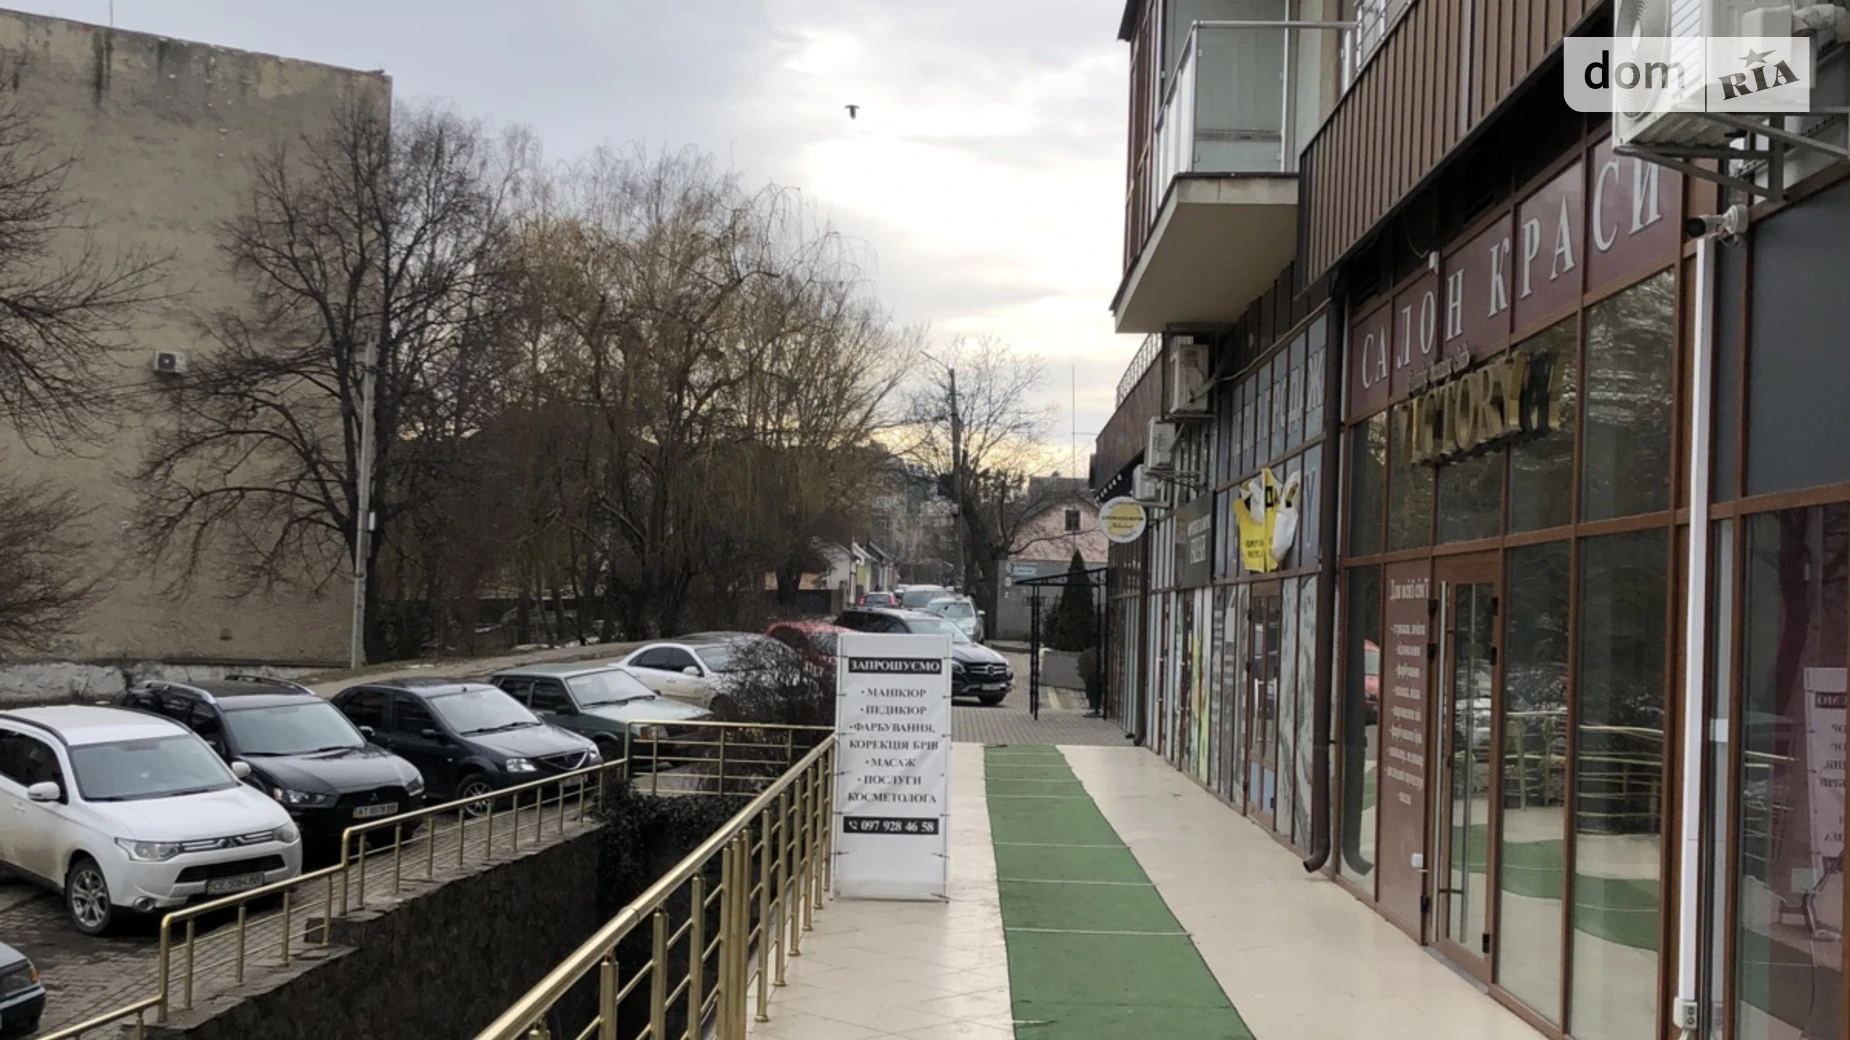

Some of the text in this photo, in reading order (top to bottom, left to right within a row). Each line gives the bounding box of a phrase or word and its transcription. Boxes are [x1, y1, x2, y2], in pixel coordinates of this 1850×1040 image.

[1362, 157, 1662, 389] САЛОН КРАСИ
[850, 659, 940, 673] ЗАПРОШУЄМО
[866, 688, 927, 699] МАНІКЮР
[866, 705, 927, 716] ПЕДИКЮР
[850, 739, 939, 751] КОРЕКЦІЯ БРІВ
[870, 757, 917, 768] МАСАЖ
[863, 775, 922, 786] ПОСЛУГИ
[848, 792, 937, 804] КОСМЕТОЛОГА
[860, 820, 934, 833] 097 928 46 58
